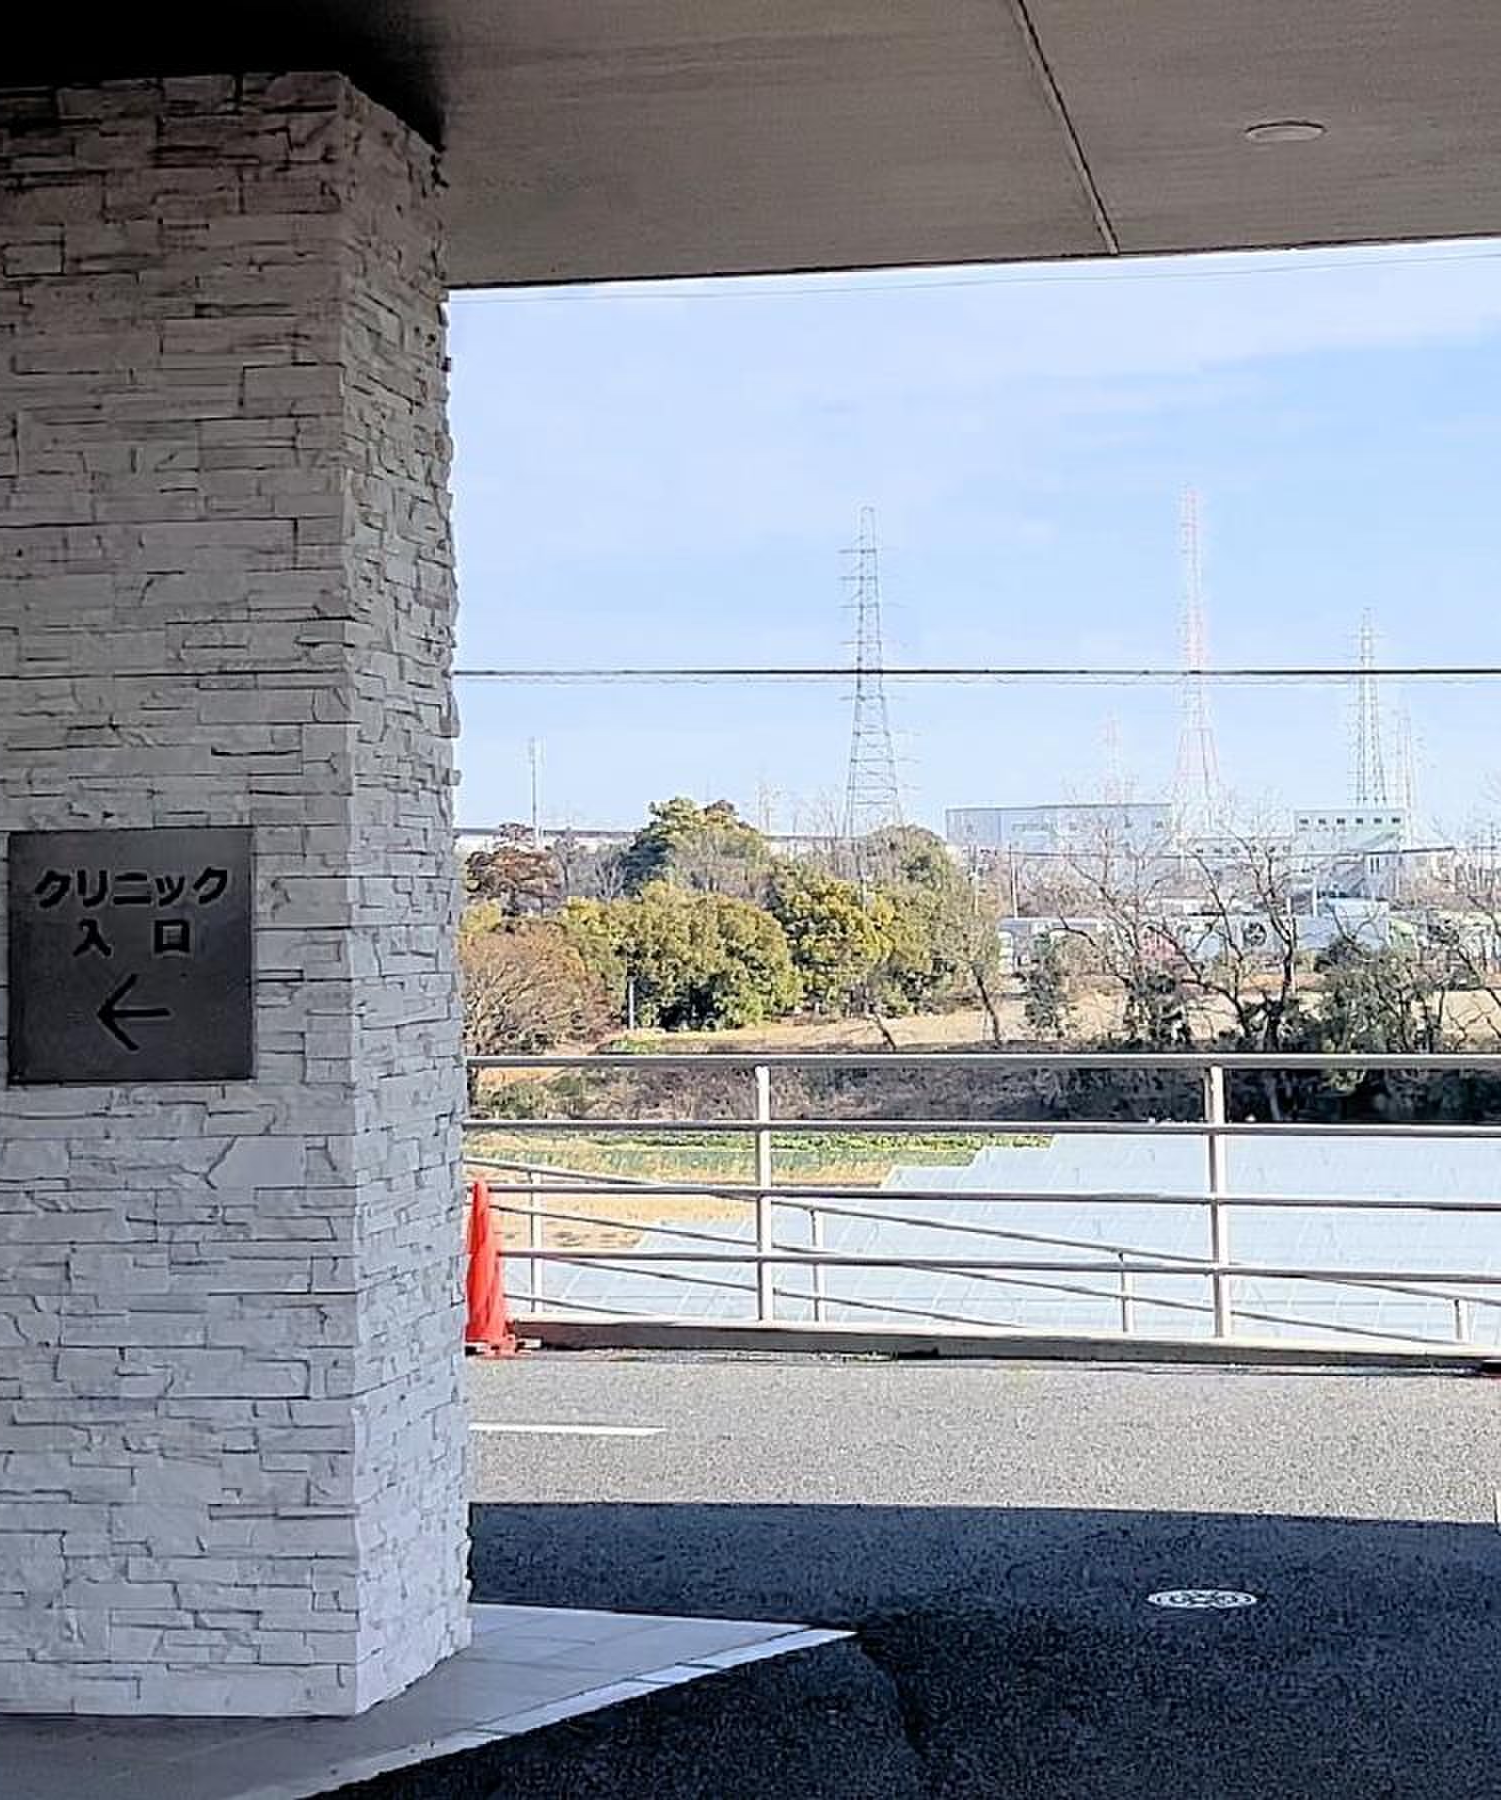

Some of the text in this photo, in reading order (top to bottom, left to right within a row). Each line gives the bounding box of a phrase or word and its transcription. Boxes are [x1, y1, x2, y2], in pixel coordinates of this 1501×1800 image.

[35, 866, 229, 908] クリニック
[72, 917, 191, 957] 入口
